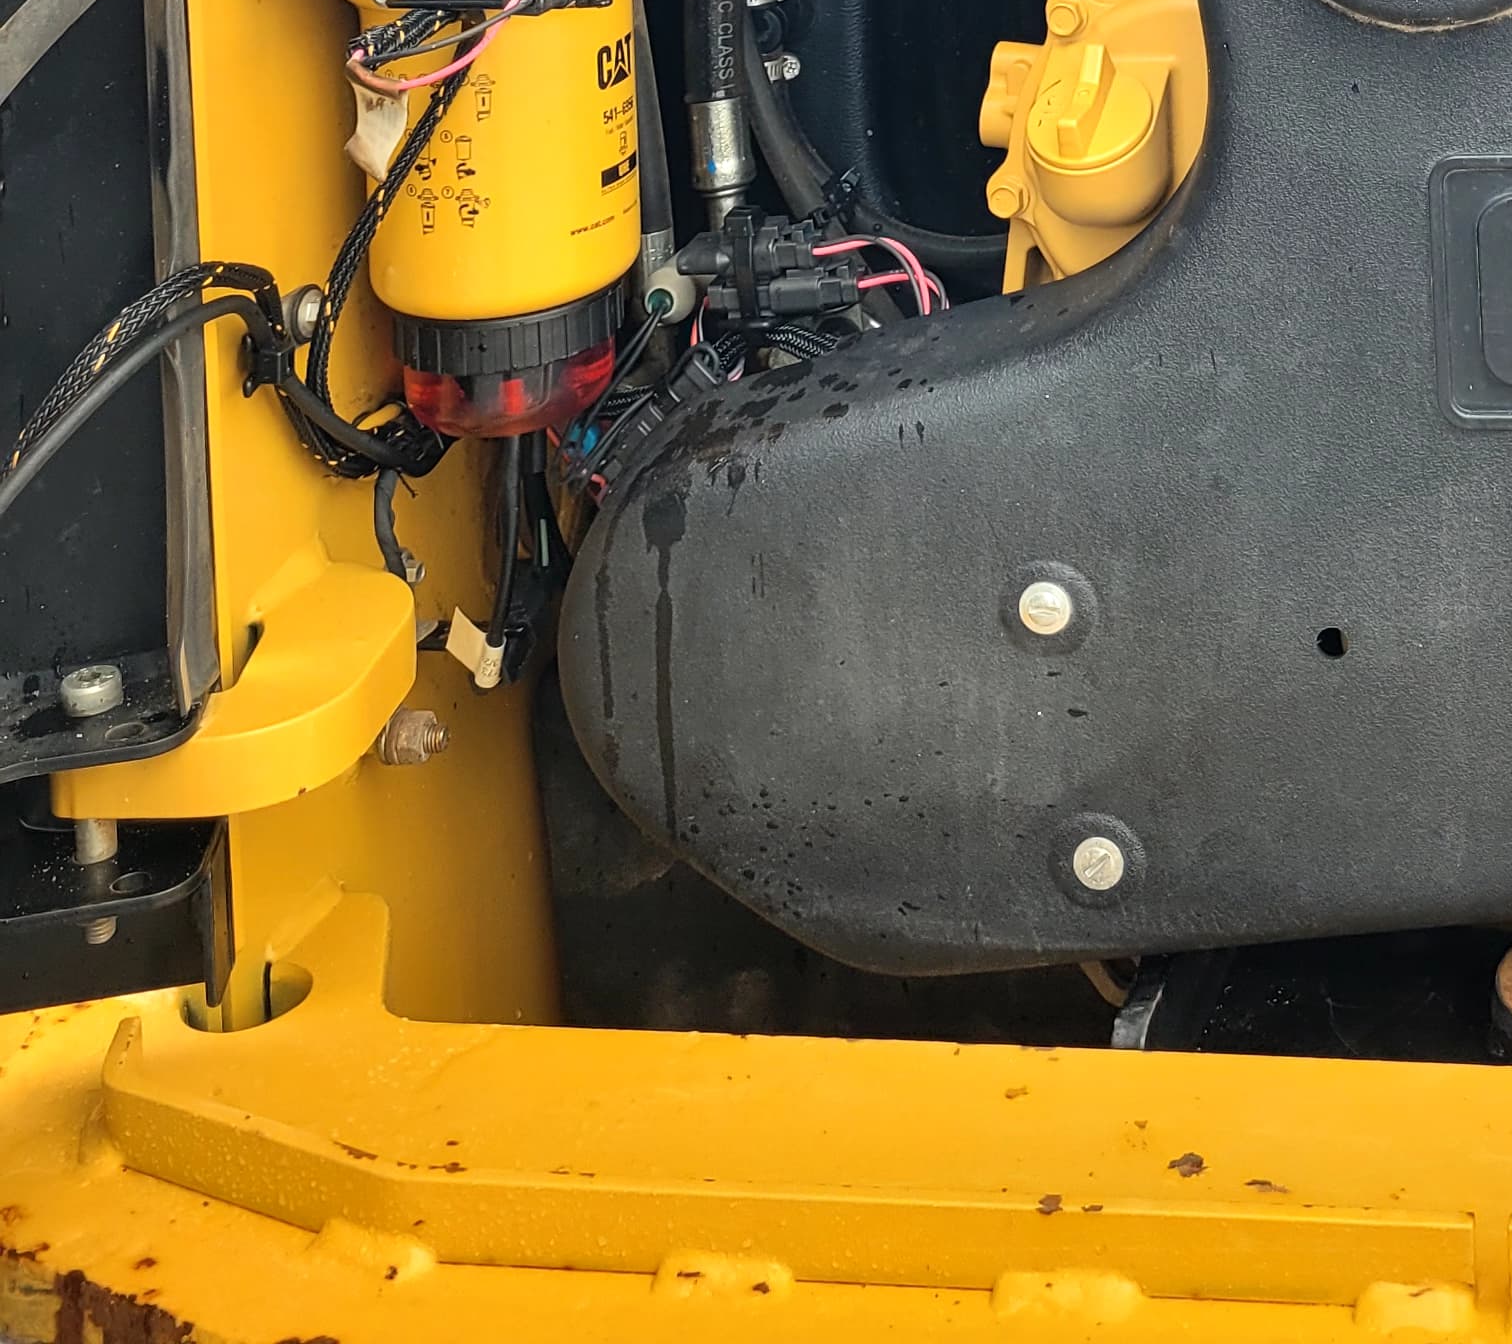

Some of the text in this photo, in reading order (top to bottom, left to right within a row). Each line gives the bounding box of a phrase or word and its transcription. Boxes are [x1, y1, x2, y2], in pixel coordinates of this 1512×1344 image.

[718, 0, 735, 14] C
[597, 31, 633, 90] CAT
[717, 22, 735, 81] CLASS
